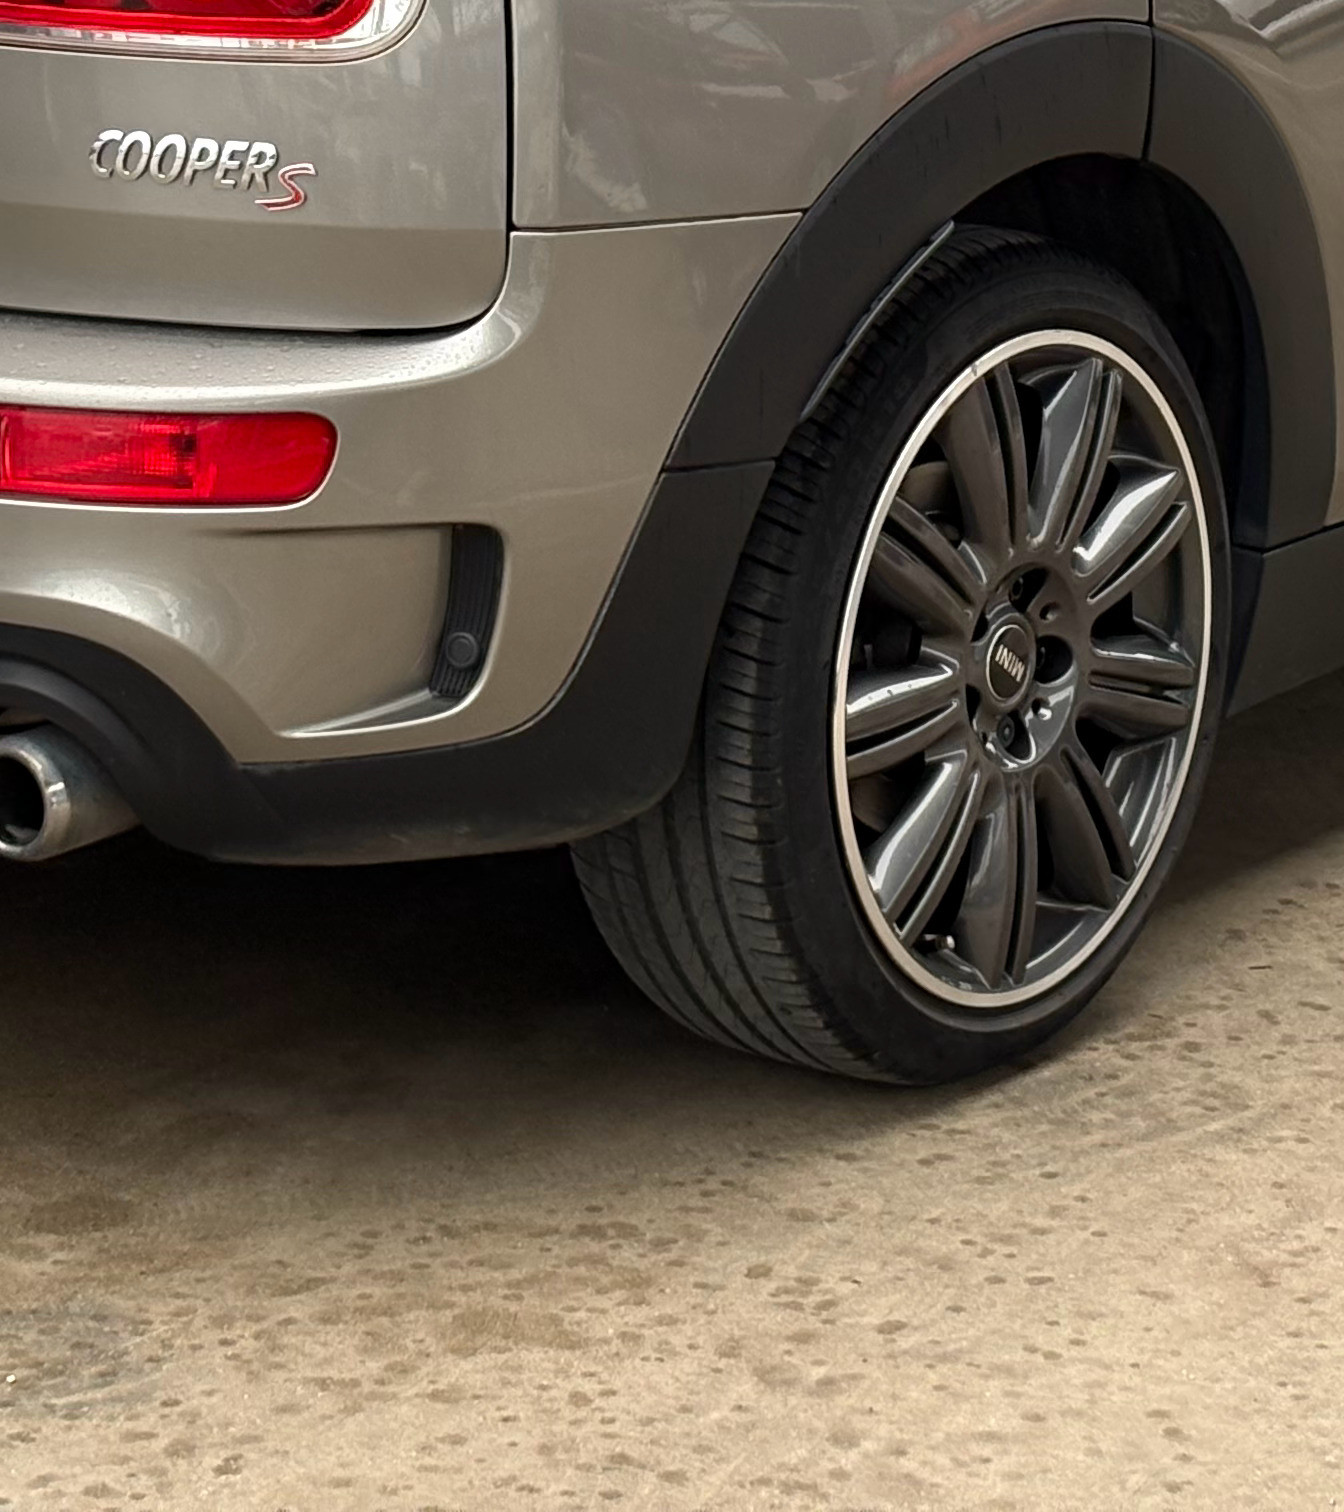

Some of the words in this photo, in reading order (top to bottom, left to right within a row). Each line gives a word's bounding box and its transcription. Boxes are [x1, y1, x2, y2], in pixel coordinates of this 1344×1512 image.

[89, 129, 279, 193] COOPER
[254, 163, 317, 212] S
[995, 643, 1026, 682] MINI
